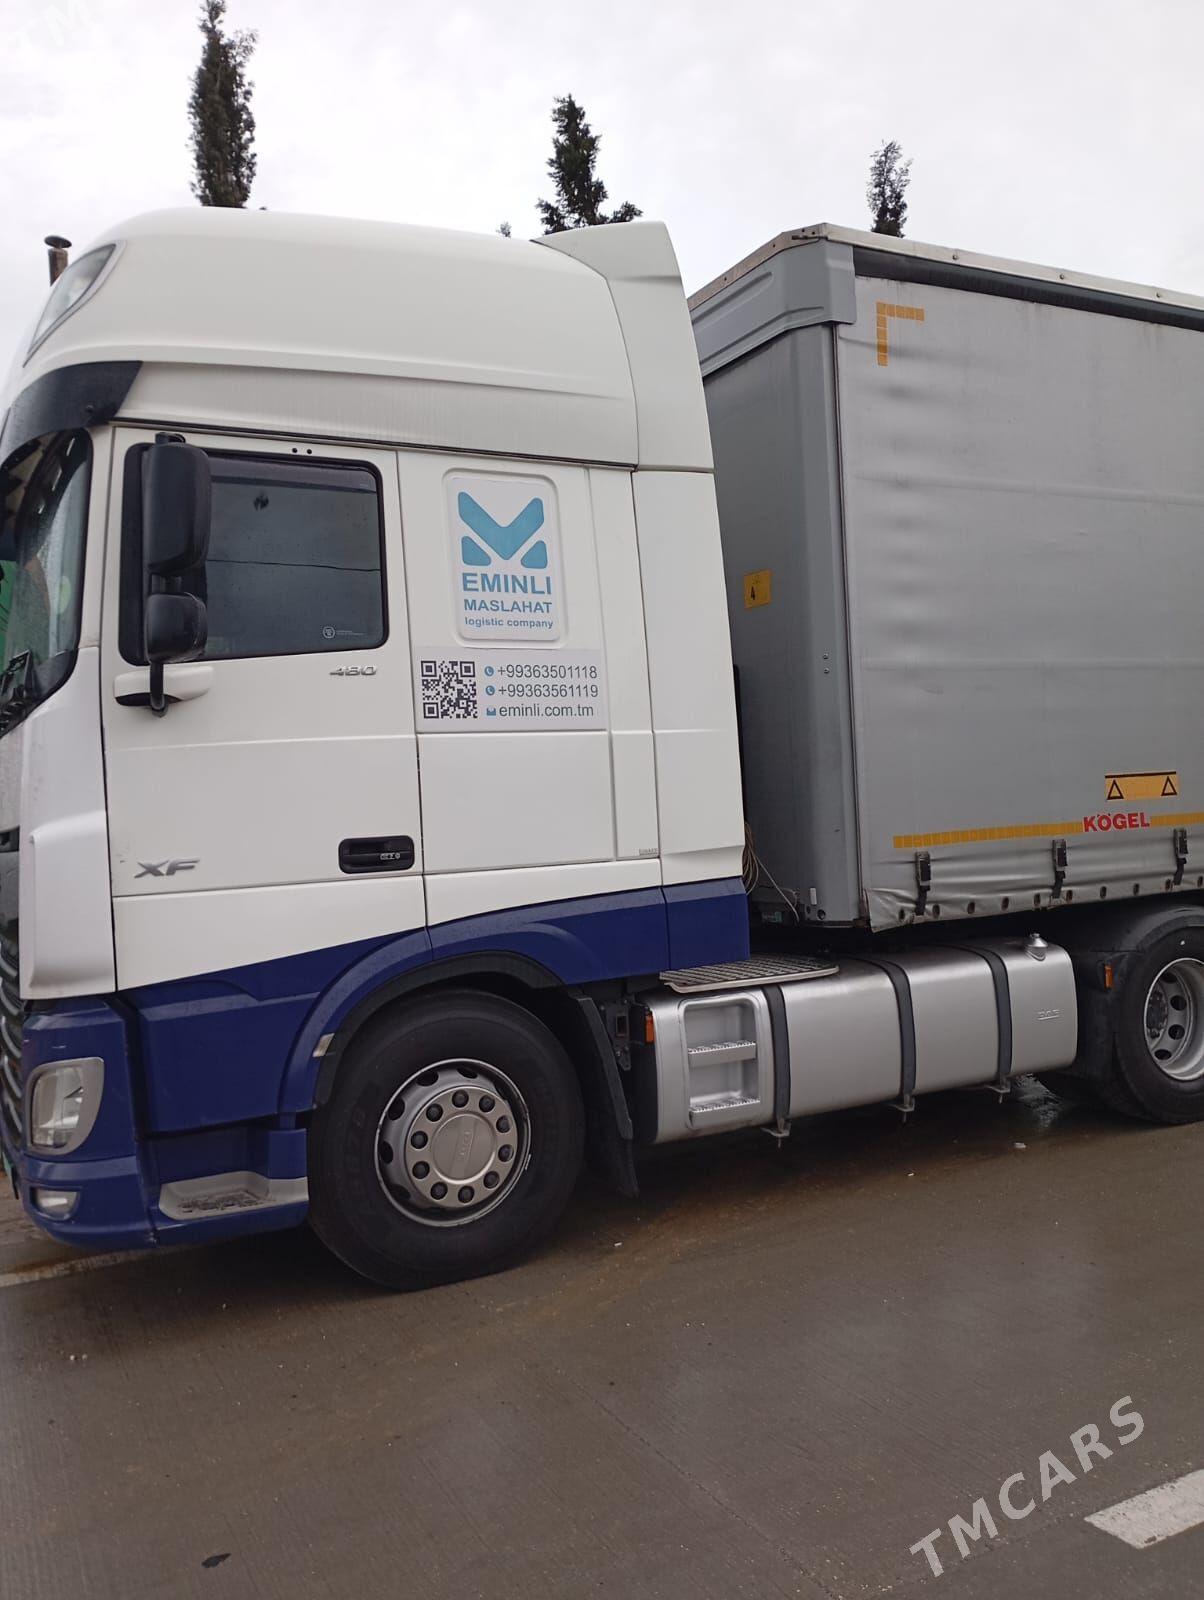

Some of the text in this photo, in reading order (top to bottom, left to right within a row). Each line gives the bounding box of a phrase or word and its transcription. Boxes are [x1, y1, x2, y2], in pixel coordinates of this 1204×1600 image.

[462, 572, 552, 595] EMINLI
[463, 598, 552, 613] MASLAHAT
[464, 616, 554, 630] logistic company
[497, 664, 598, 679] +99363501118
[498, 683, 599, 698] +99363561119
[499, 703, 594, 717] eminli.com.tm
[1083, 811, 1150, 832] KÖGEL
[134, 859, 200, 879] XF
